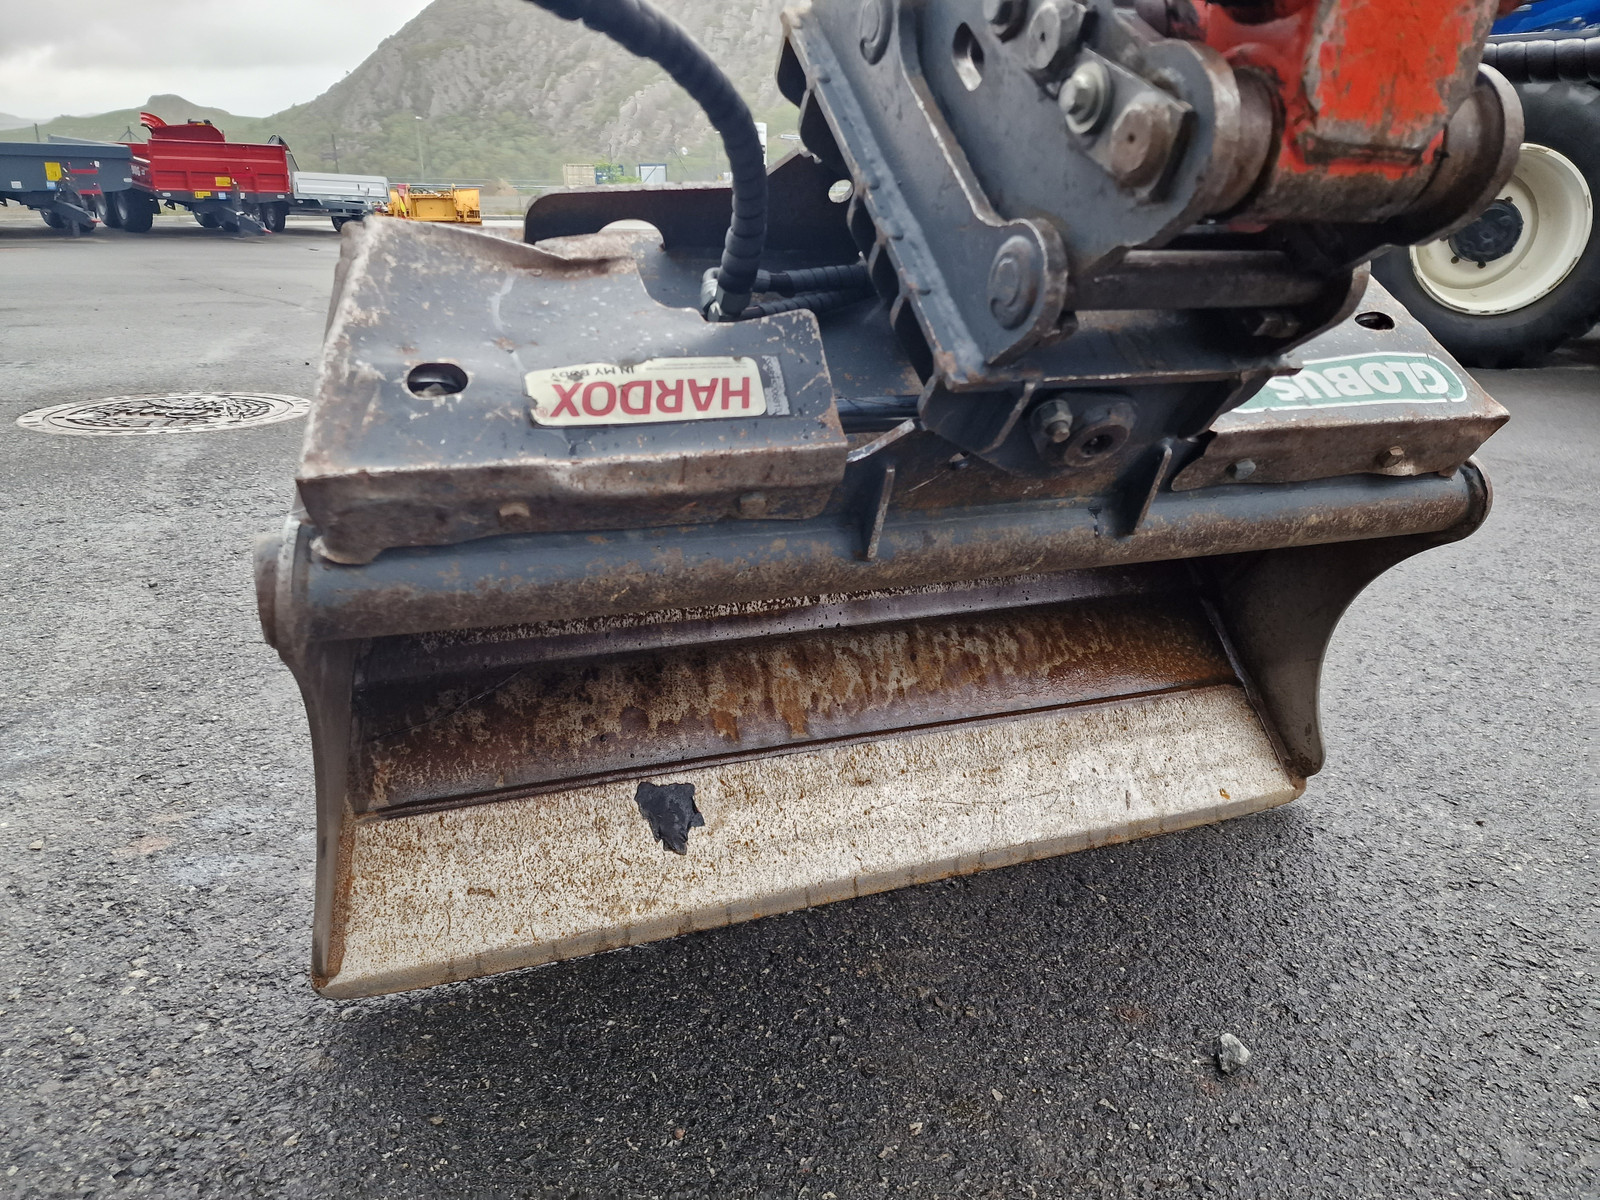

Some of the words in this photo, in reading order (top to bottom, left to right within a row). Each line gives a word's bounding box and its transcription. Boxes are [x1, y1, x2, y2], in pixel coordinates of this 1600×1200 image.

[595, 366, 616, 375] MY
[1266, 362, 1450, 400] GLOBUS
[550, 377, 750, 417] HARDOX
